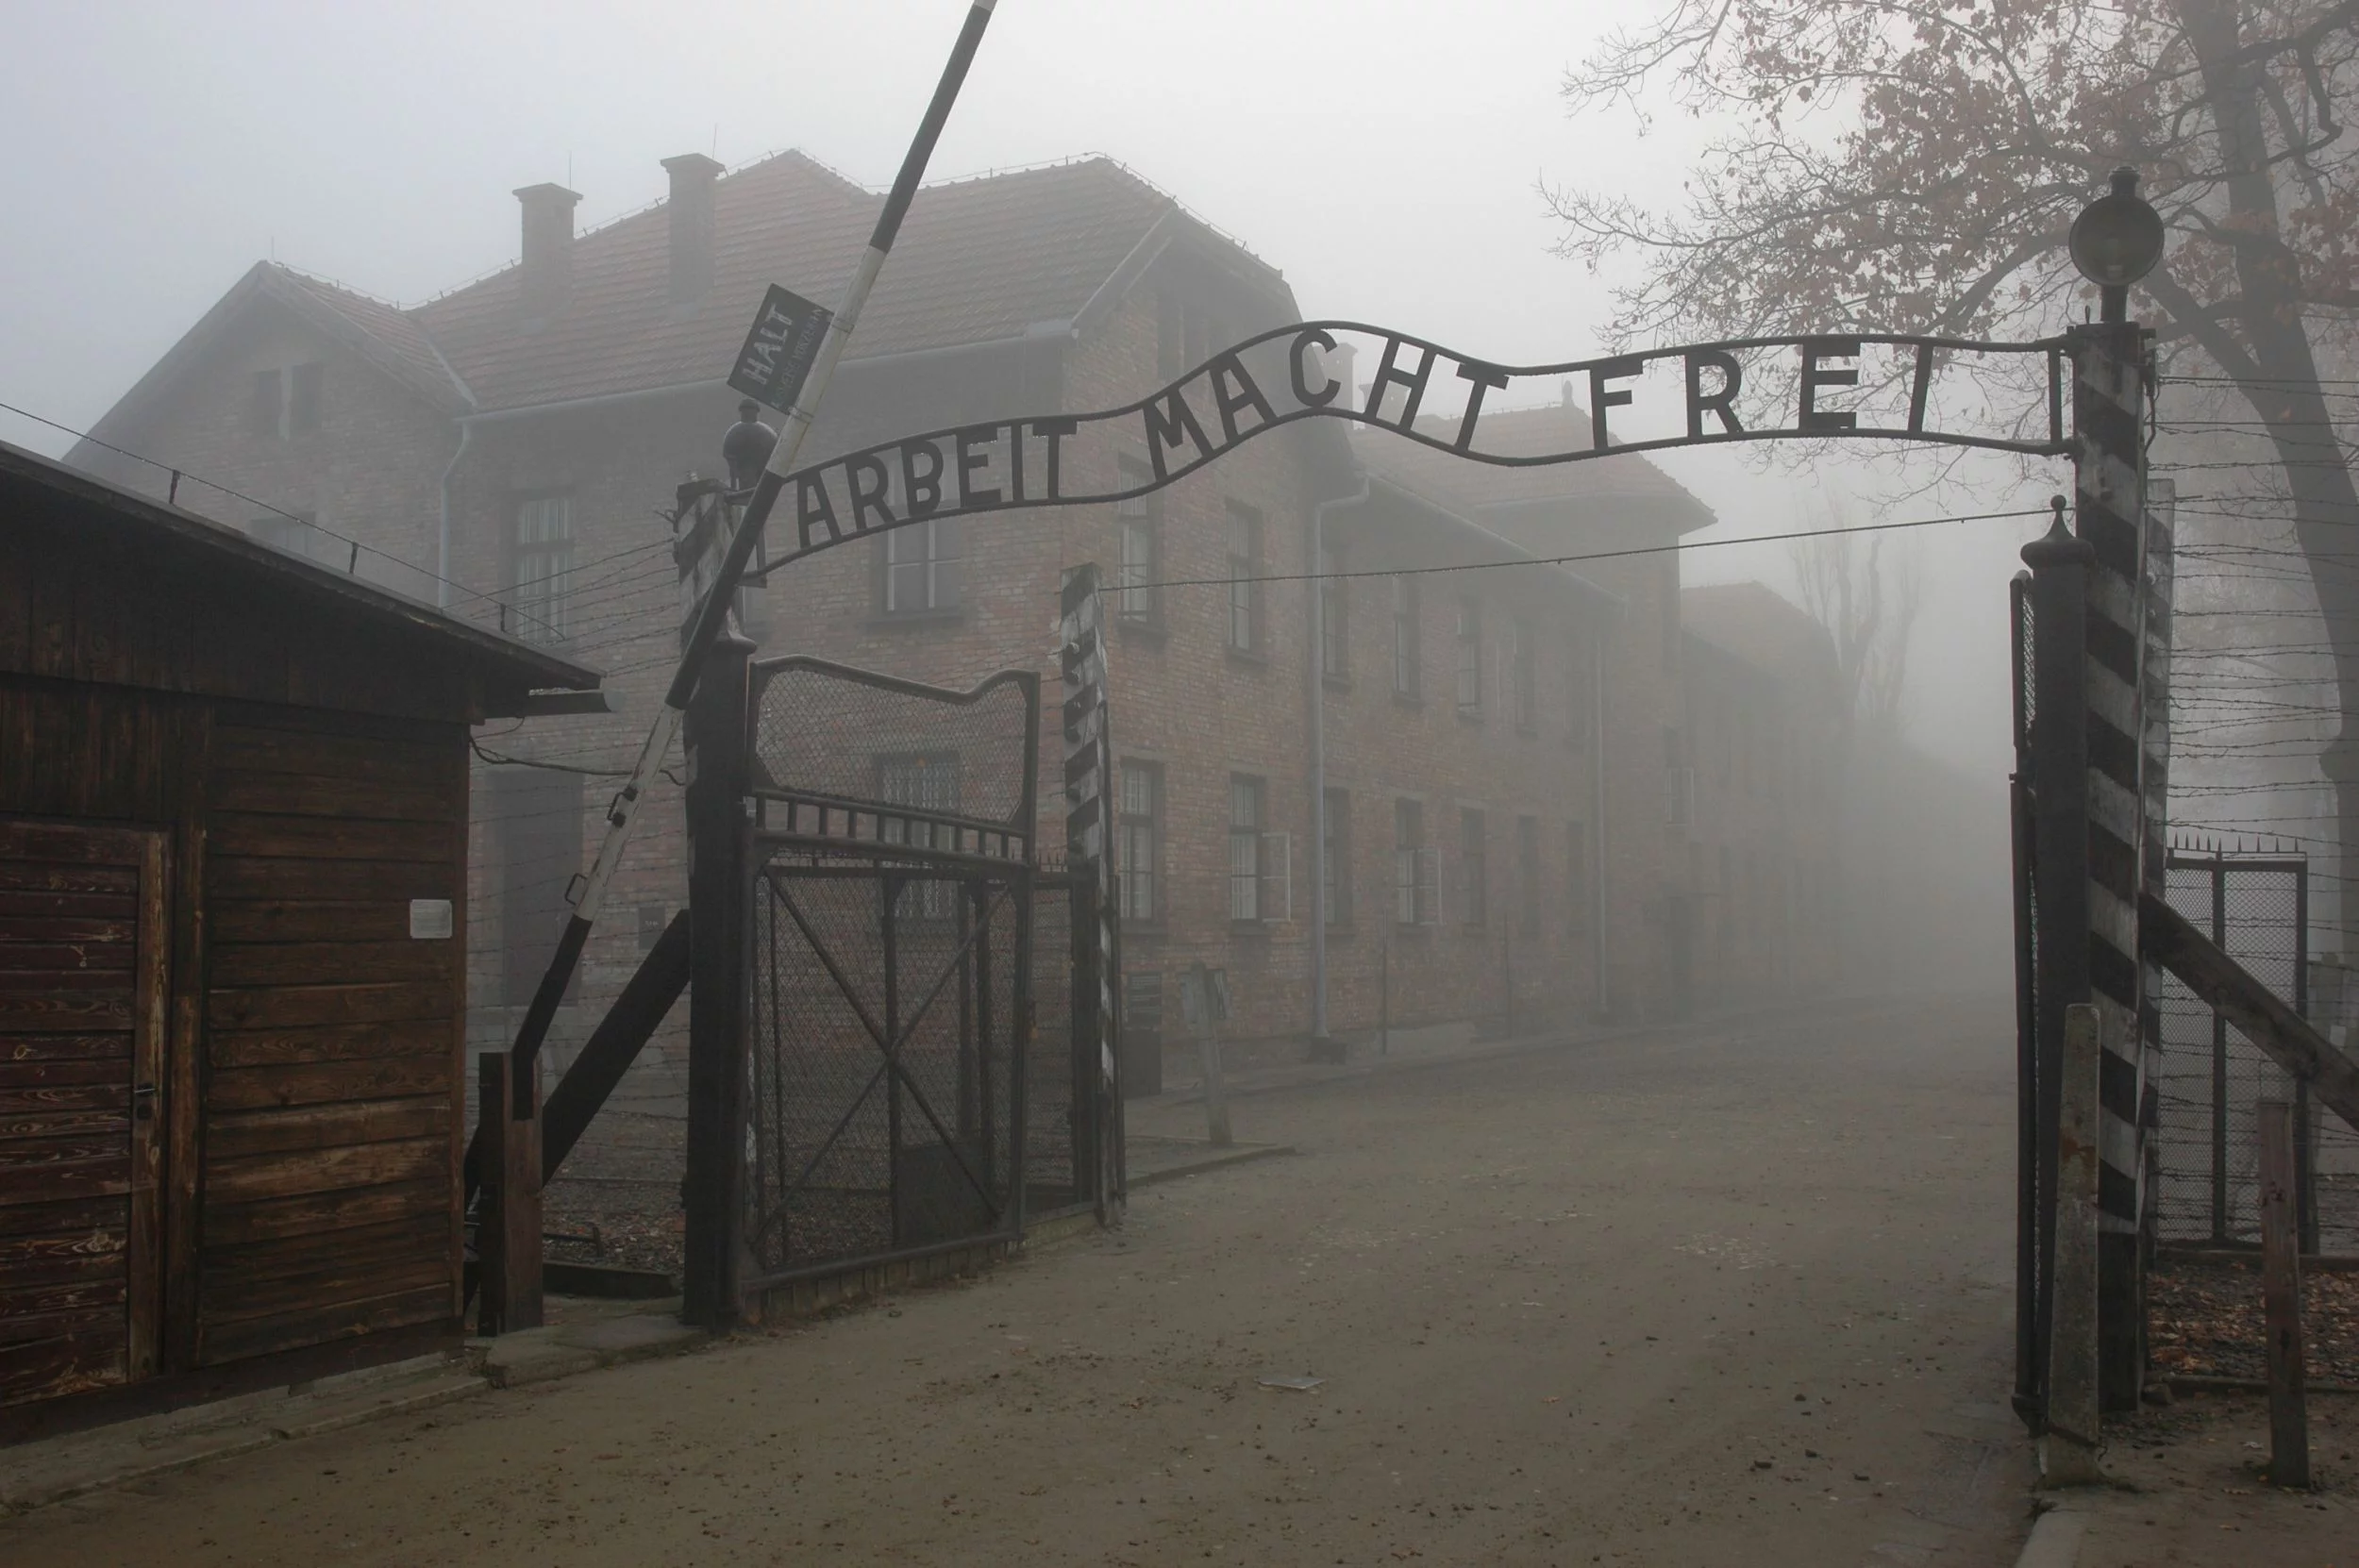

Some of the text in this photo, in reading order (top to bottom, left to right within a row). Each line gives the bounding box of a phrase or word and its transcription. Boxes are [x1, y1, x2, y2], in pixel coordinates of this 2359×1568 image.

[742, 303, 793, 386] HALT
[795, 328, 1933, 549] ARBEIT MACHT FREI
